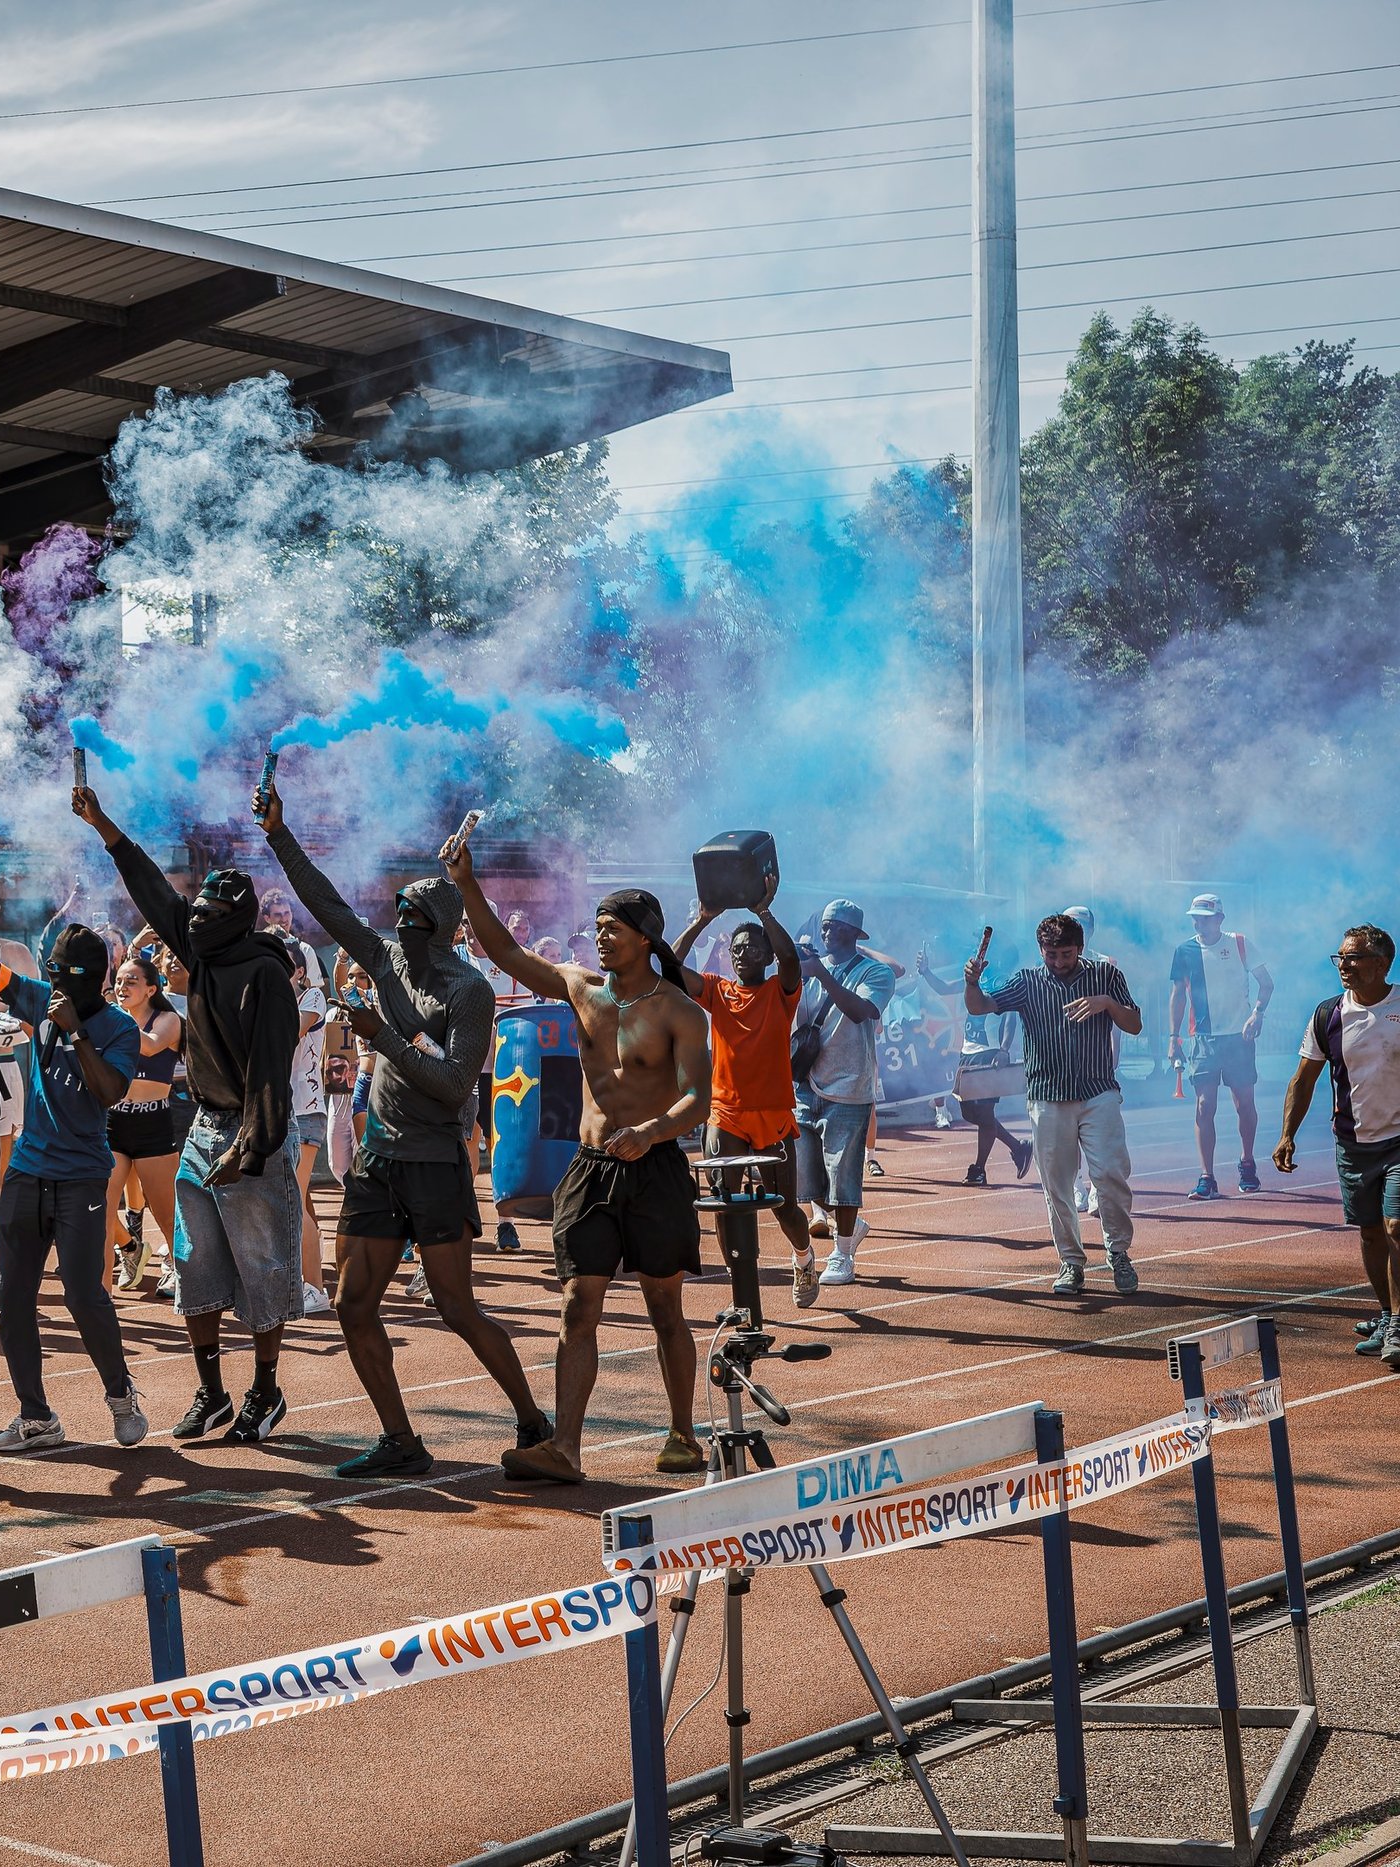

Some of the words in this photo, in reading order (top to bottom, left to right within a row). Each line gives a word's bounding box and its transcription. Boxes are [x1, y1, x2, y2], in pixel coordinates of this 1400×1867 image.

[885, 1043, 919, 1072] 31
[131, 1101, 158, 1113] PRO
[797, 1448, 903, 1510] DIMA
[1028, 1447, 1130, 1510] INTERSPORT
[857, 1482, 1001, 1549] INTERSPORT
